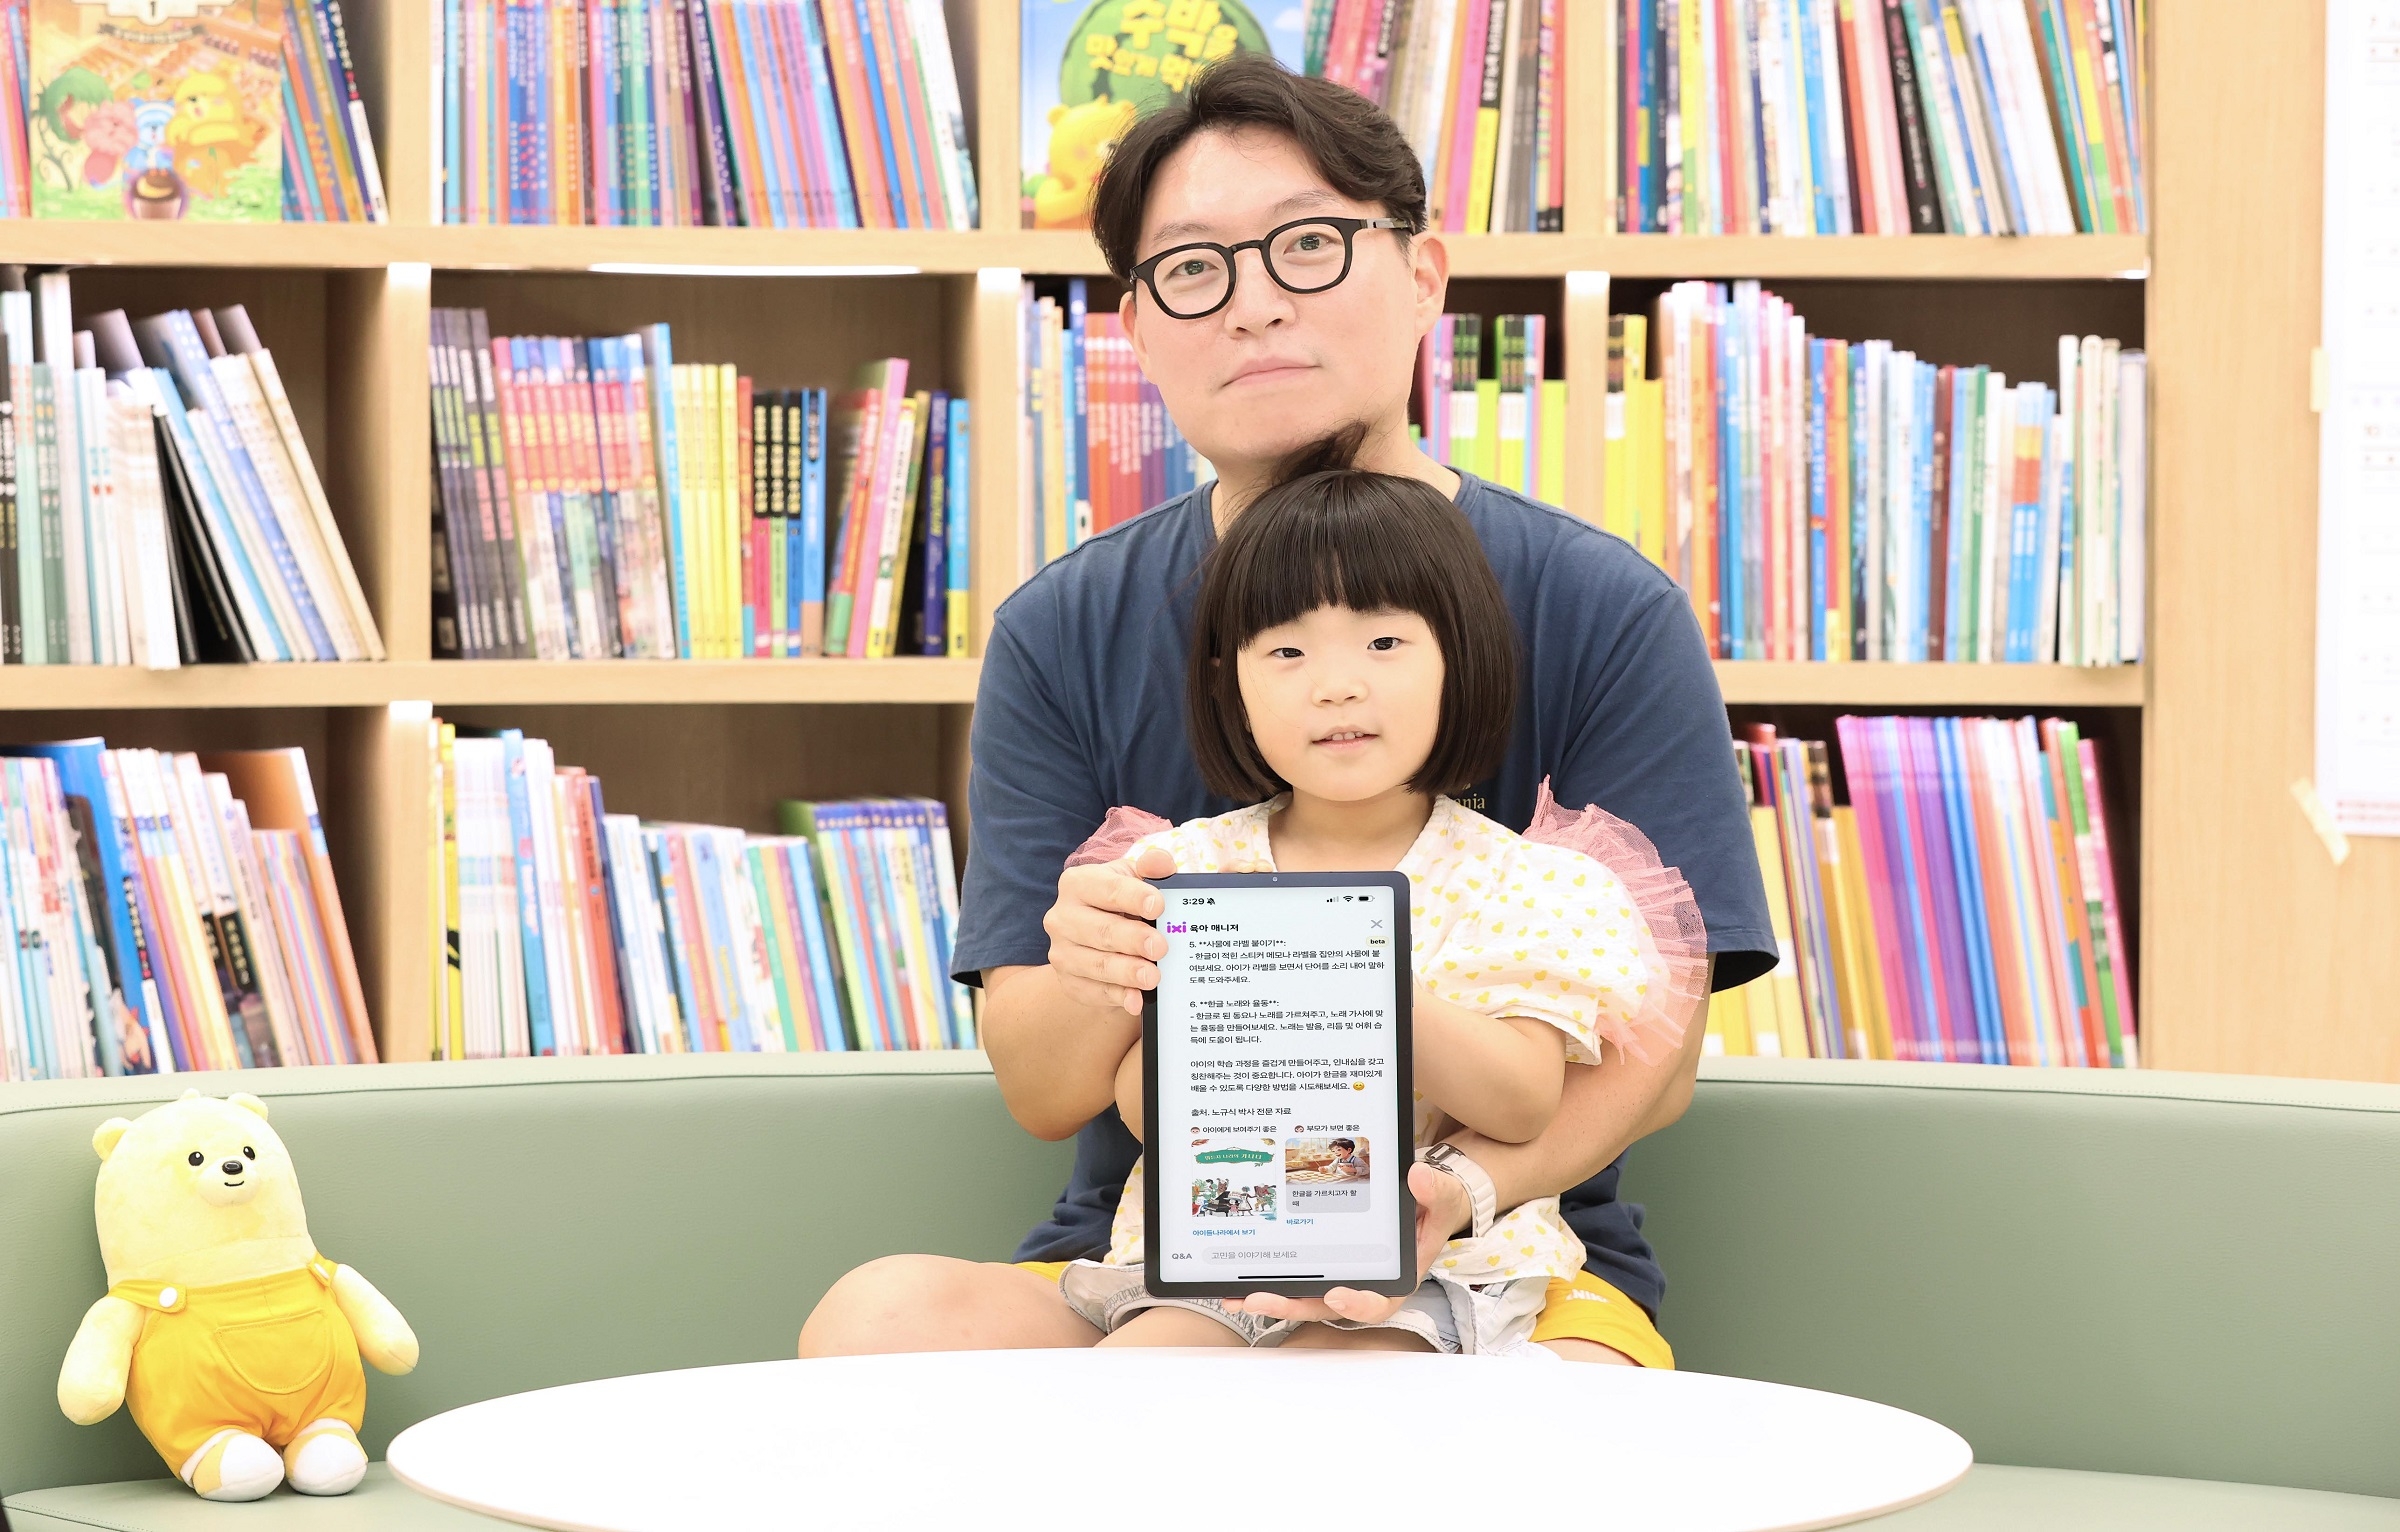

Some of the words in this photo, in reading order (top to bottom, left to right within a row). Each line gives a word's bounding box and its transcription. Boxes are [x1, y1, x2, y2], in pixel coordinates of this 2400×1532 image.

[1167, 922, 1187, 933] ixi
[1196, 1012, 1220, 1020] 한글로
[1286, 1010, 1328, 1018] 가르쳐주고,
[1200, 1024, 1224, 1032] 율동을
[1191, 1060, 1214, 1068] 아이의
[1288, 1059, 1330, 1067] 만들어주고,
[1333, 1058, 1366, 1066] 인내심을
[1191, 1072, 1231, 1080] 칭찬해주는
[1350, 1070, 1382, 1078] 재미있게
[1299, 1082, 1349, 1090] 시도해보세요.
[1212, 1108, 1236, 1116] 노규식
[1273, 1251, 1297, 1259] 보세요
